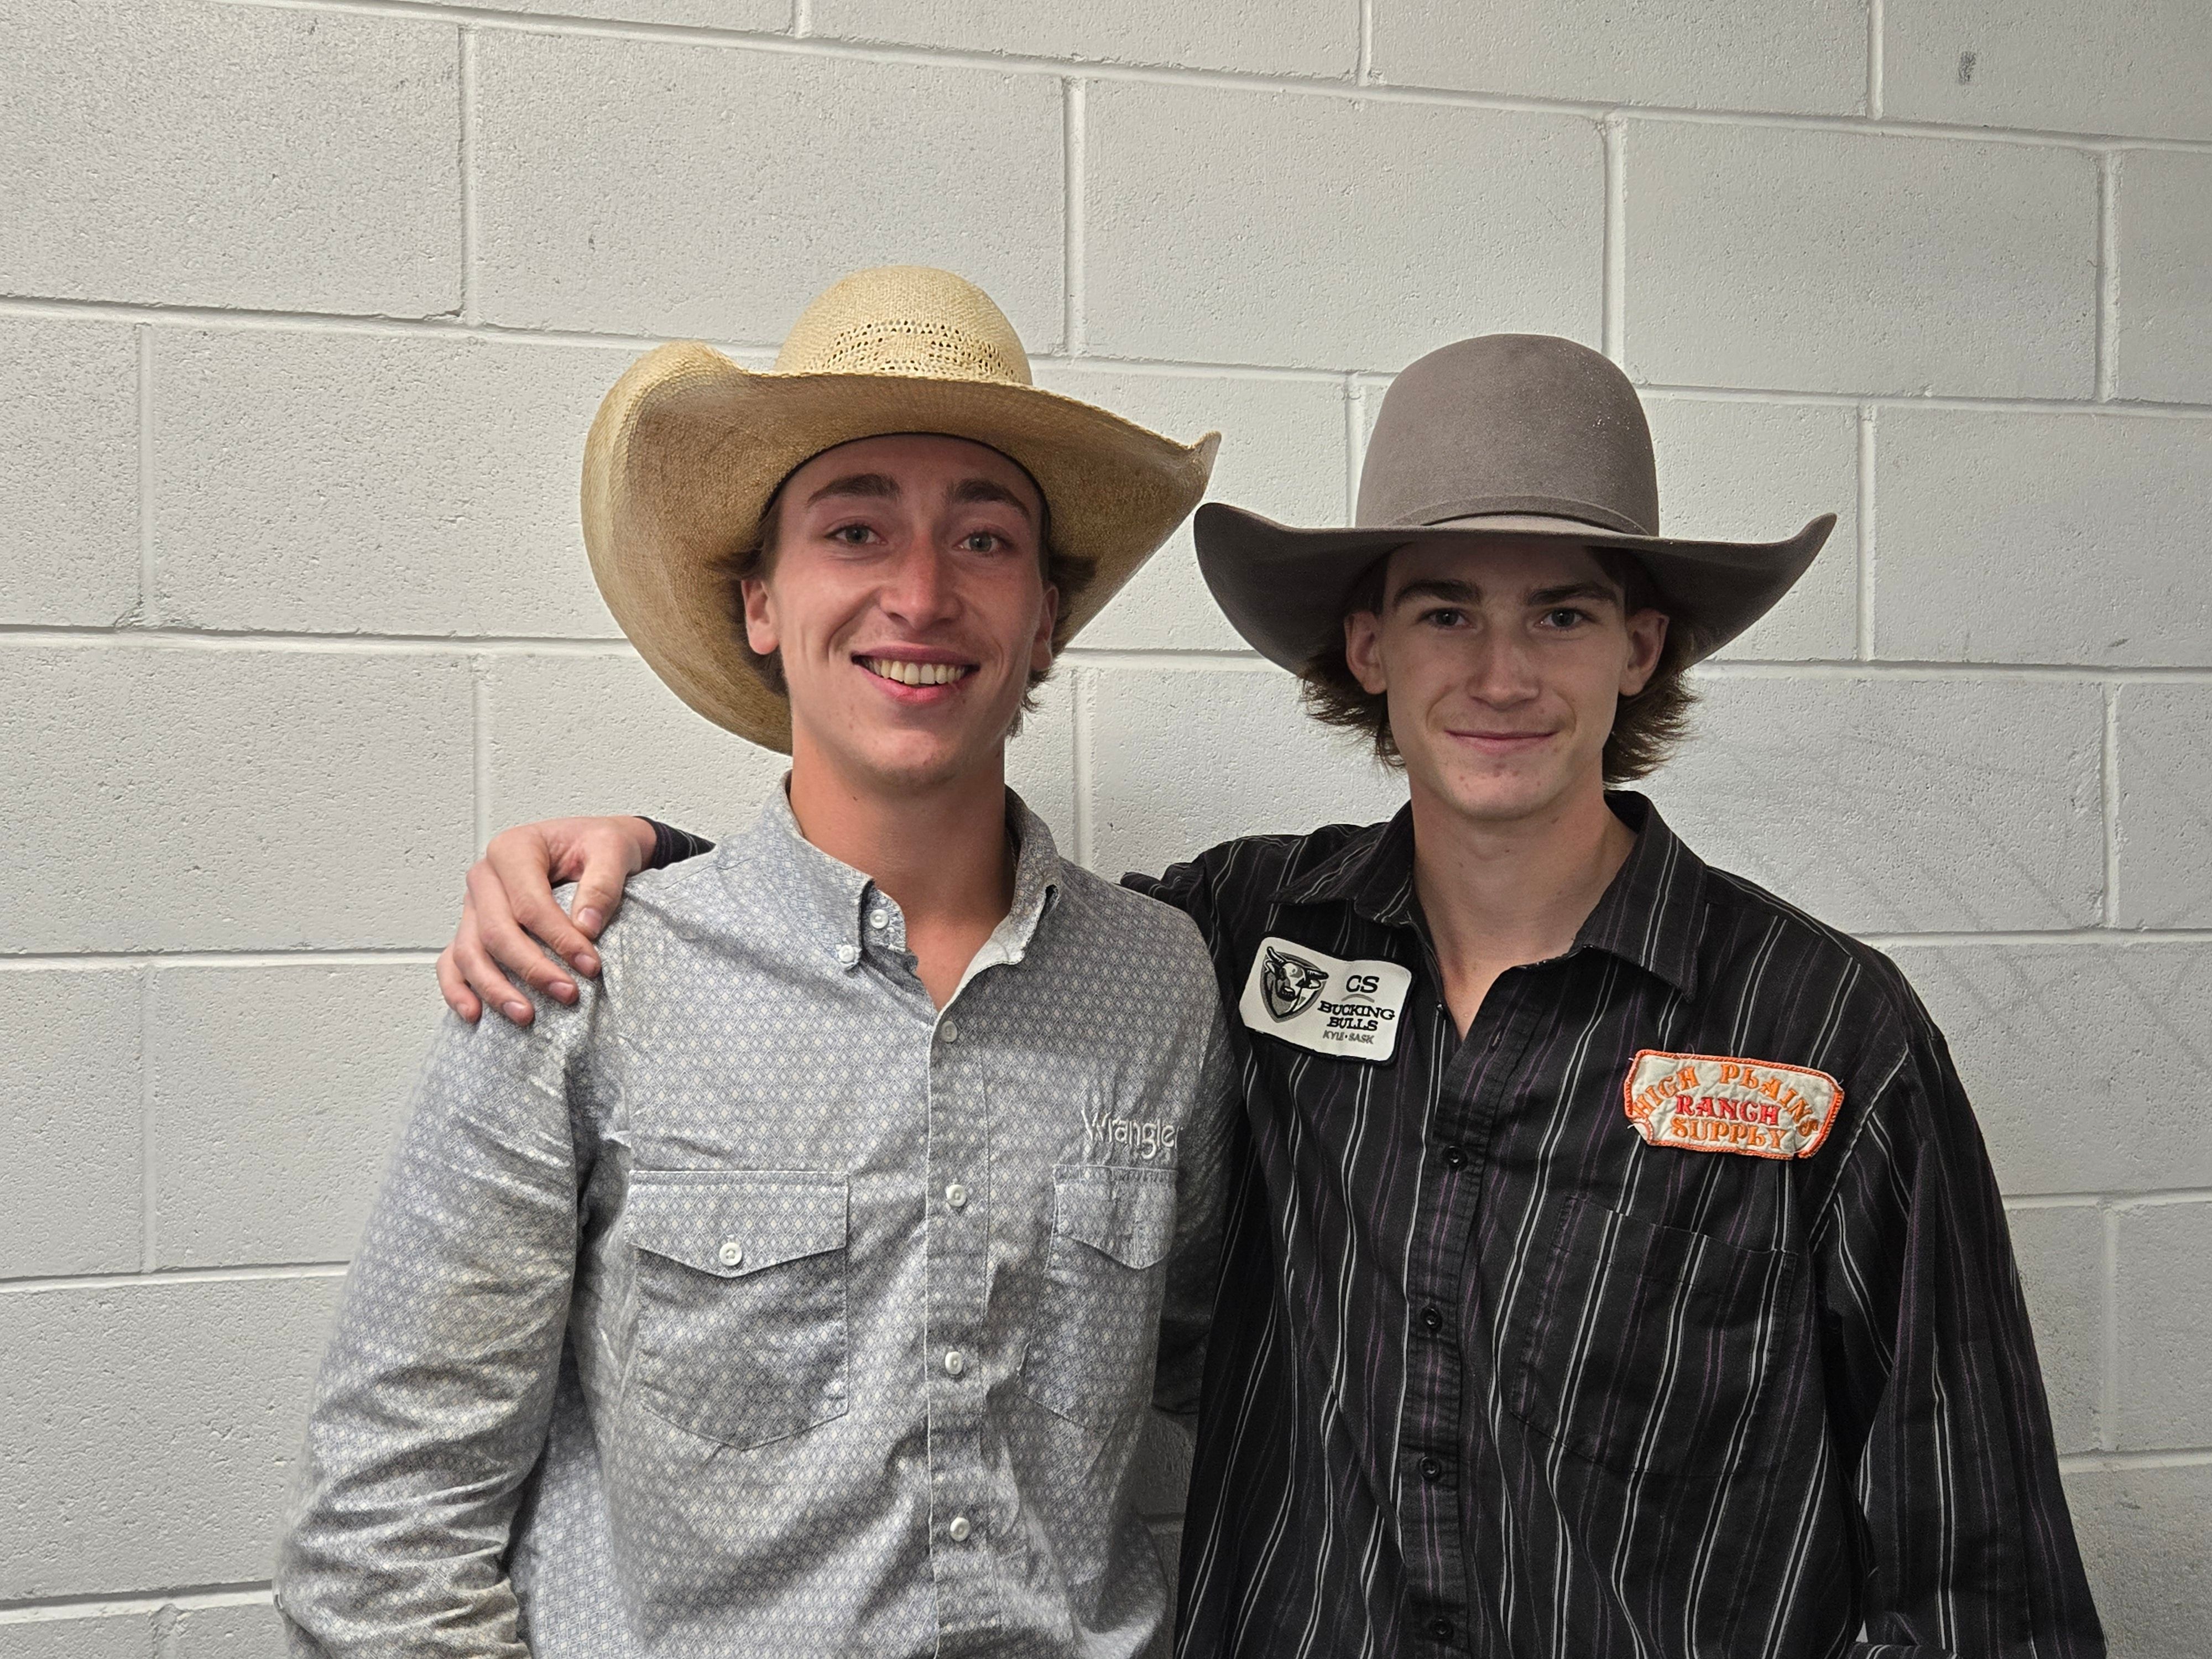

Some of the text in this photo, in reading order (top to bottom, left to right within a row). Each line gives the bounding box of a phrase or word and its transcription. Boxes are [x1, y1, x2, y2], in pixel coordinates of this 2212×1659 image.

[1345, 975, 1380, 993] CS
[1317, 1000, 1395, 1020] BUCKING
[1327, 1016, 1379, 1031] BULLS
[1632, 1064, 1819, 1137] HIGH PLAINS
[1674, 1094, 1782, 1126] RANCH
[1670, 1116, 1788, 1149] SUPPLY
